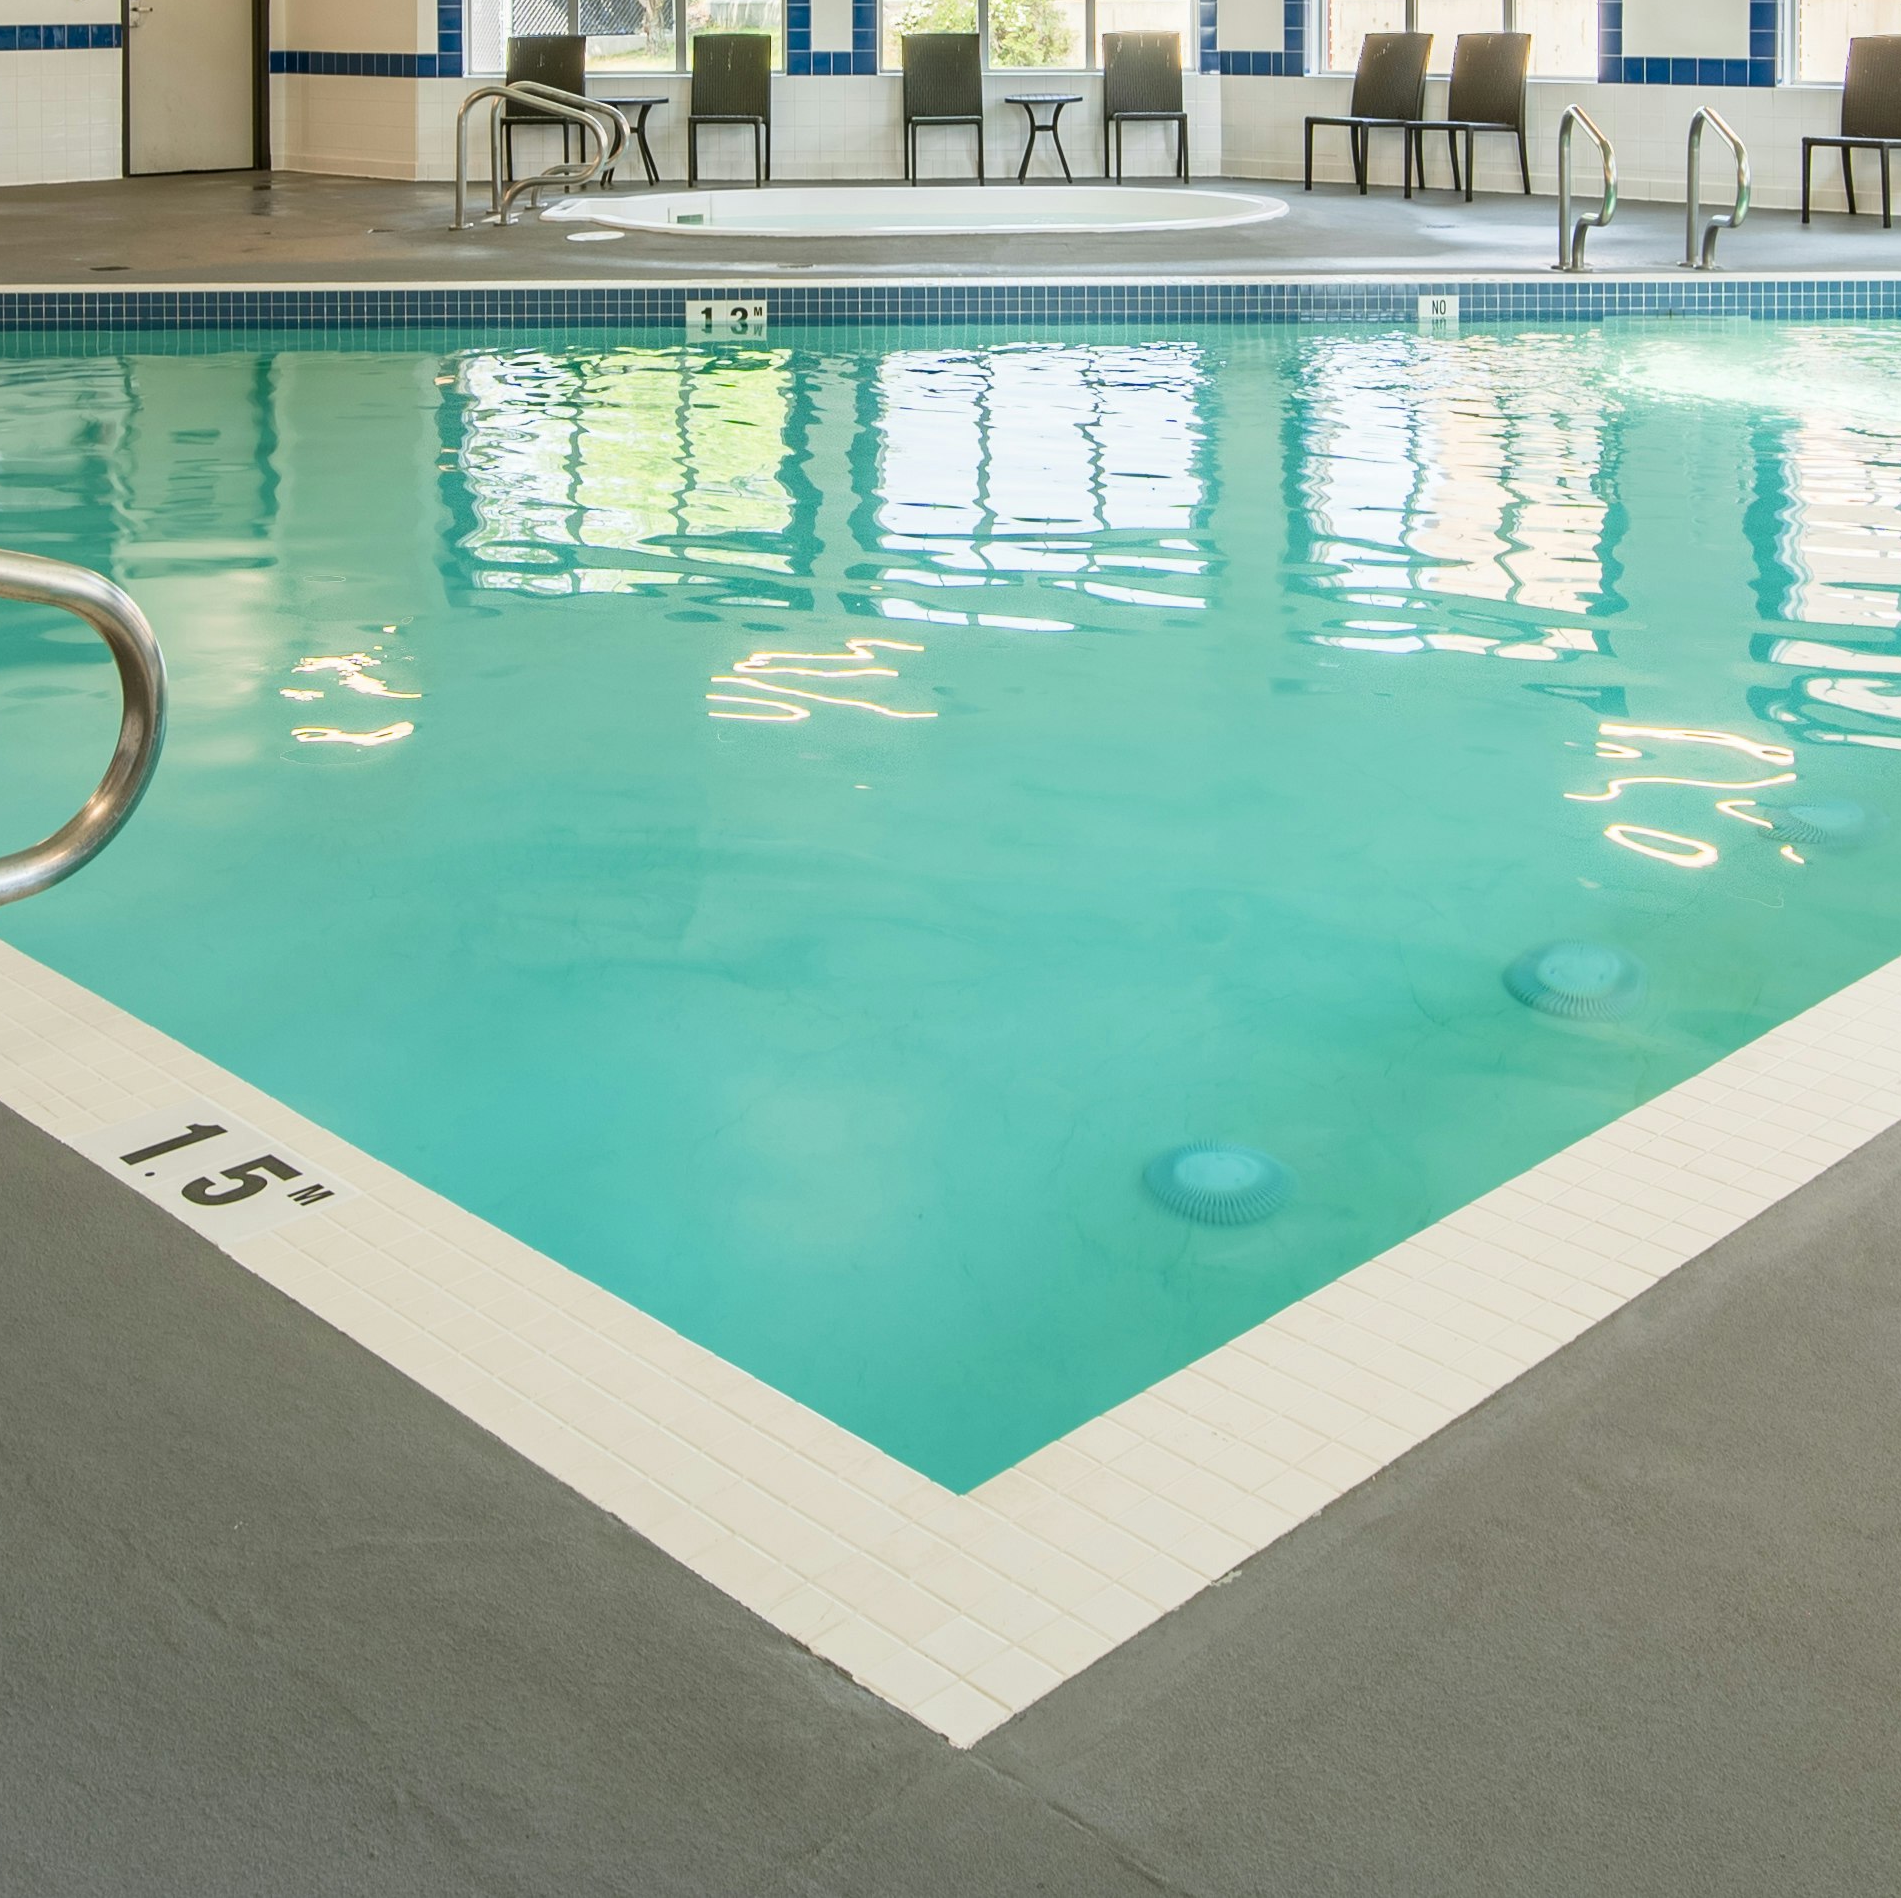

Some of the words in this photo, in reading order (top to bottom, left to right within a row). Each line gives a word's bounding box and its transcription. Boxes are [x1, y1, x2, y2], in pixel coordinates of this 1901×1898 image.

[1431, 299, 1446, 315] NO
[118, 1123, 304, 1207] 1.5
[287, 1183, 335, 1207] M
